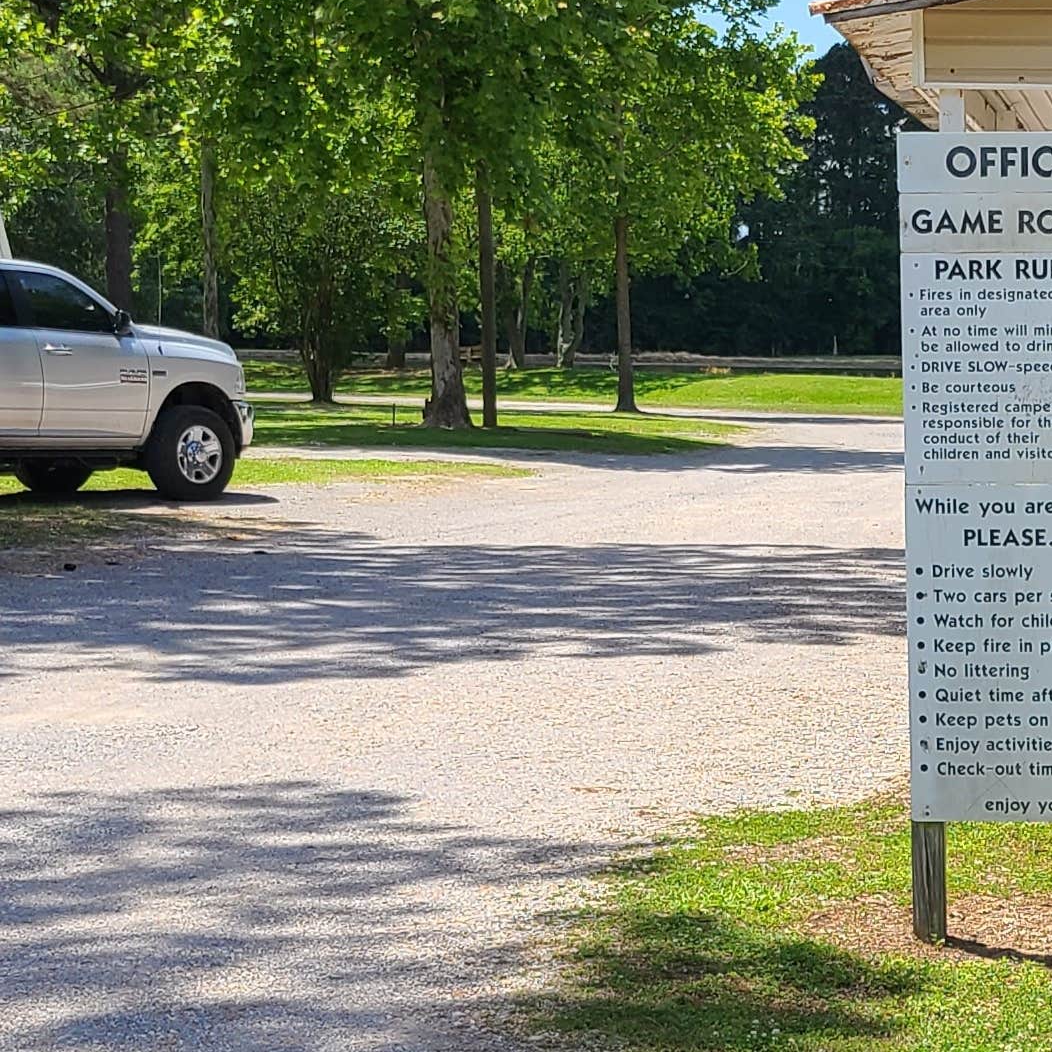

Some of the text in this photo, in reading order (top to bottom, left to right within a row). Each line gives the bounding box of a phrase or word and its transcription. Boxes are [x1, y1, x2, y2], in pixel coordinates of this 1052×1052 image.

[912, 210, 1003, 234] GAME
[936, 260, 1002, 280] PARK
[920, 289, 952, 300] Fires
[960, 289, 971, 300] in
[921, 305, 986, 318] area only
[922, 326, 936, 336] At
[944, 328, 960, 336] no
[968, 325, 997, 336] time
[1005, 324, 1027, 335] will
[921, 341, 938, 352] be
[946, 341, 998, 352] allowed
[1006, 341, 1020, 351] to
[922, 361, 961, 372] DRIVE
[922, 382, 1015, 393] Be courteous
[923, 402, 998, 415] Registered
[923, 417, 1004, 431] responsible
[1011, 417, 1030, 428] for
[924, 431, 1039, 444] conduct of their
[924, 448, 978, 459] children
[986, 448, 1010, 459] and
[915, 498, 969, 514] While
[979, 502, 1014, 517] you
[933, 564, 1032, 581] Drive slowly
[934, 589, 966, 602] Two
[975, 593, 1006, 602] cars
[1015, 593, 1042, 605] per
[934, 614, 983, 627] Watch
[991, 614, 1014, 627] for
[934, 639, 975, 655] Keep
[984, 639, 1011, 652] fire
[1020, 639, 1032, 652] in
[935, 663, 1029, 680] No littering
[936, 688, 981, 702] Quiet
[989, 688, 1023, 701] time
[936, 713, 977, 729] Keep
[986, 714, 1021, 729] pets
[1029, 716, 1048, 726] on
[937, 737, 979, 754] Enjoy
[938, 762, 1021, 775] Check-out
[985, 798, 1030, 814] enjoy
